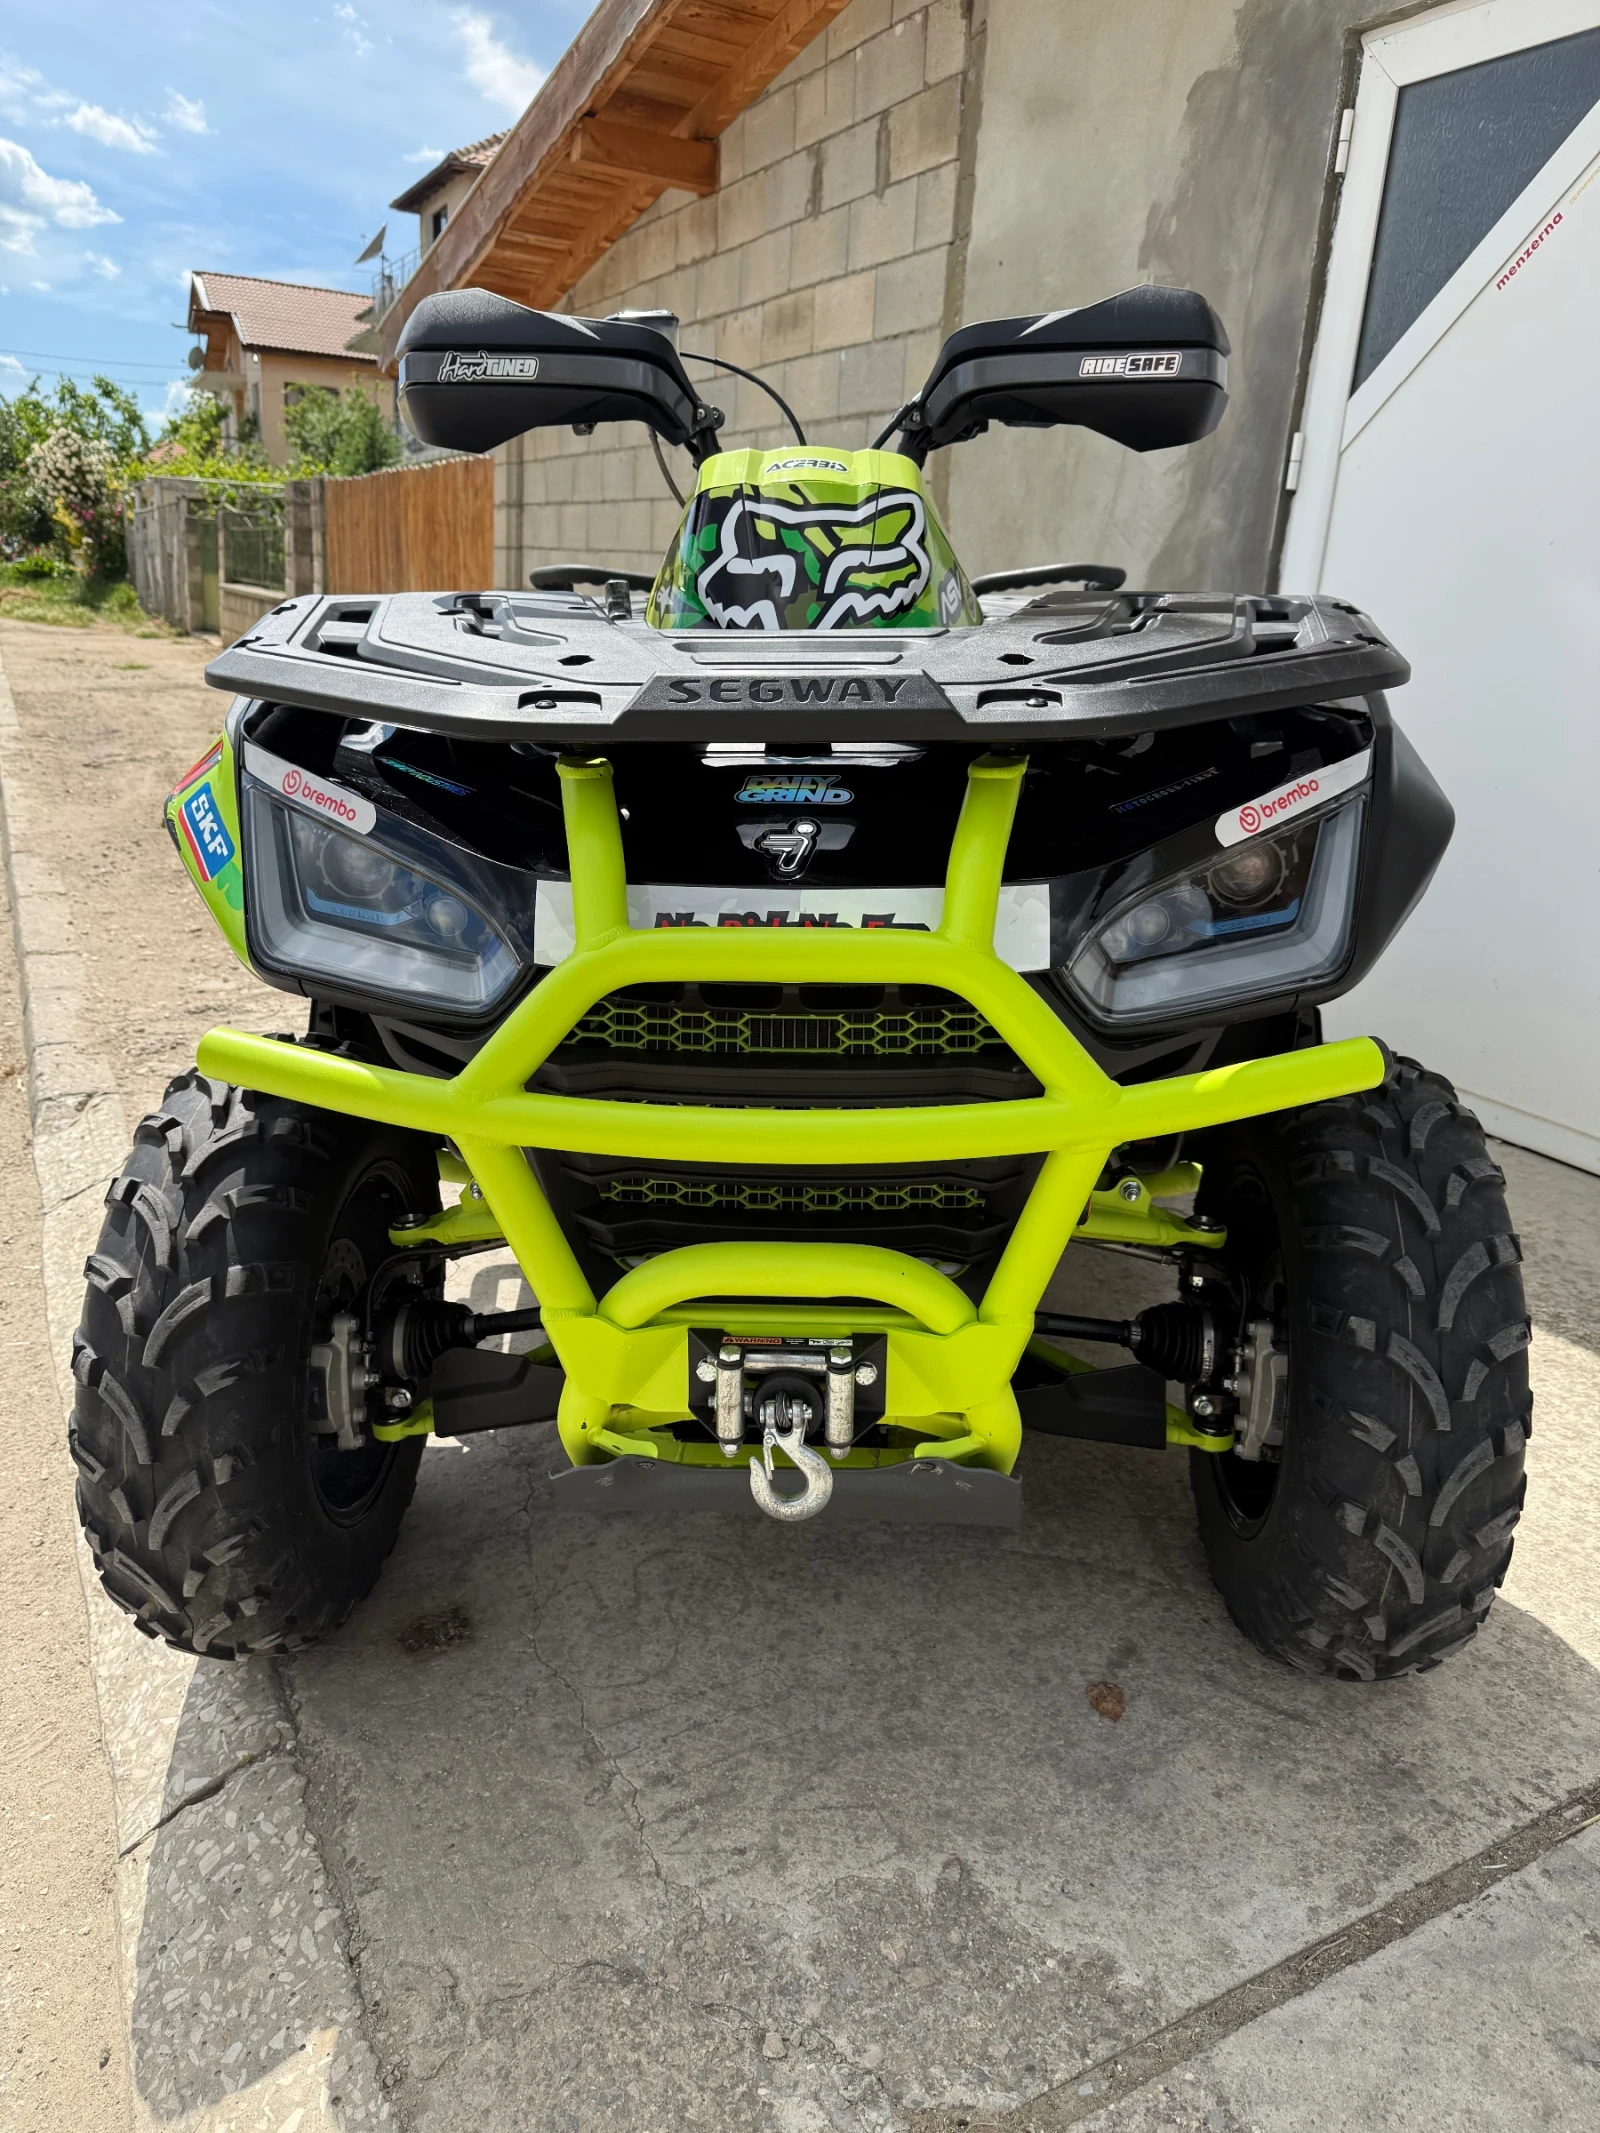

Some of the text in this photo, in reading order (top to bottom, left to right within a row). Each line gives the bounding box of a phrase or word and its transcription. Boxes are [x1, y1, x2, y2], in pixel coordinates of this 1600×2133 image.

[1496, 212, 1563, 290] menzerna
[1127, 356, 1176, 372] SAFE
[668, 678, 908, 704] SEGWAY
[738, 788, 851, 803] GRIND
[745, 776, 837, 790] DAILY
[1260, 779, 1319, 818] brembo
[301, 781, 357, 821] brembo
[191, 793, 228, 857] SKF
